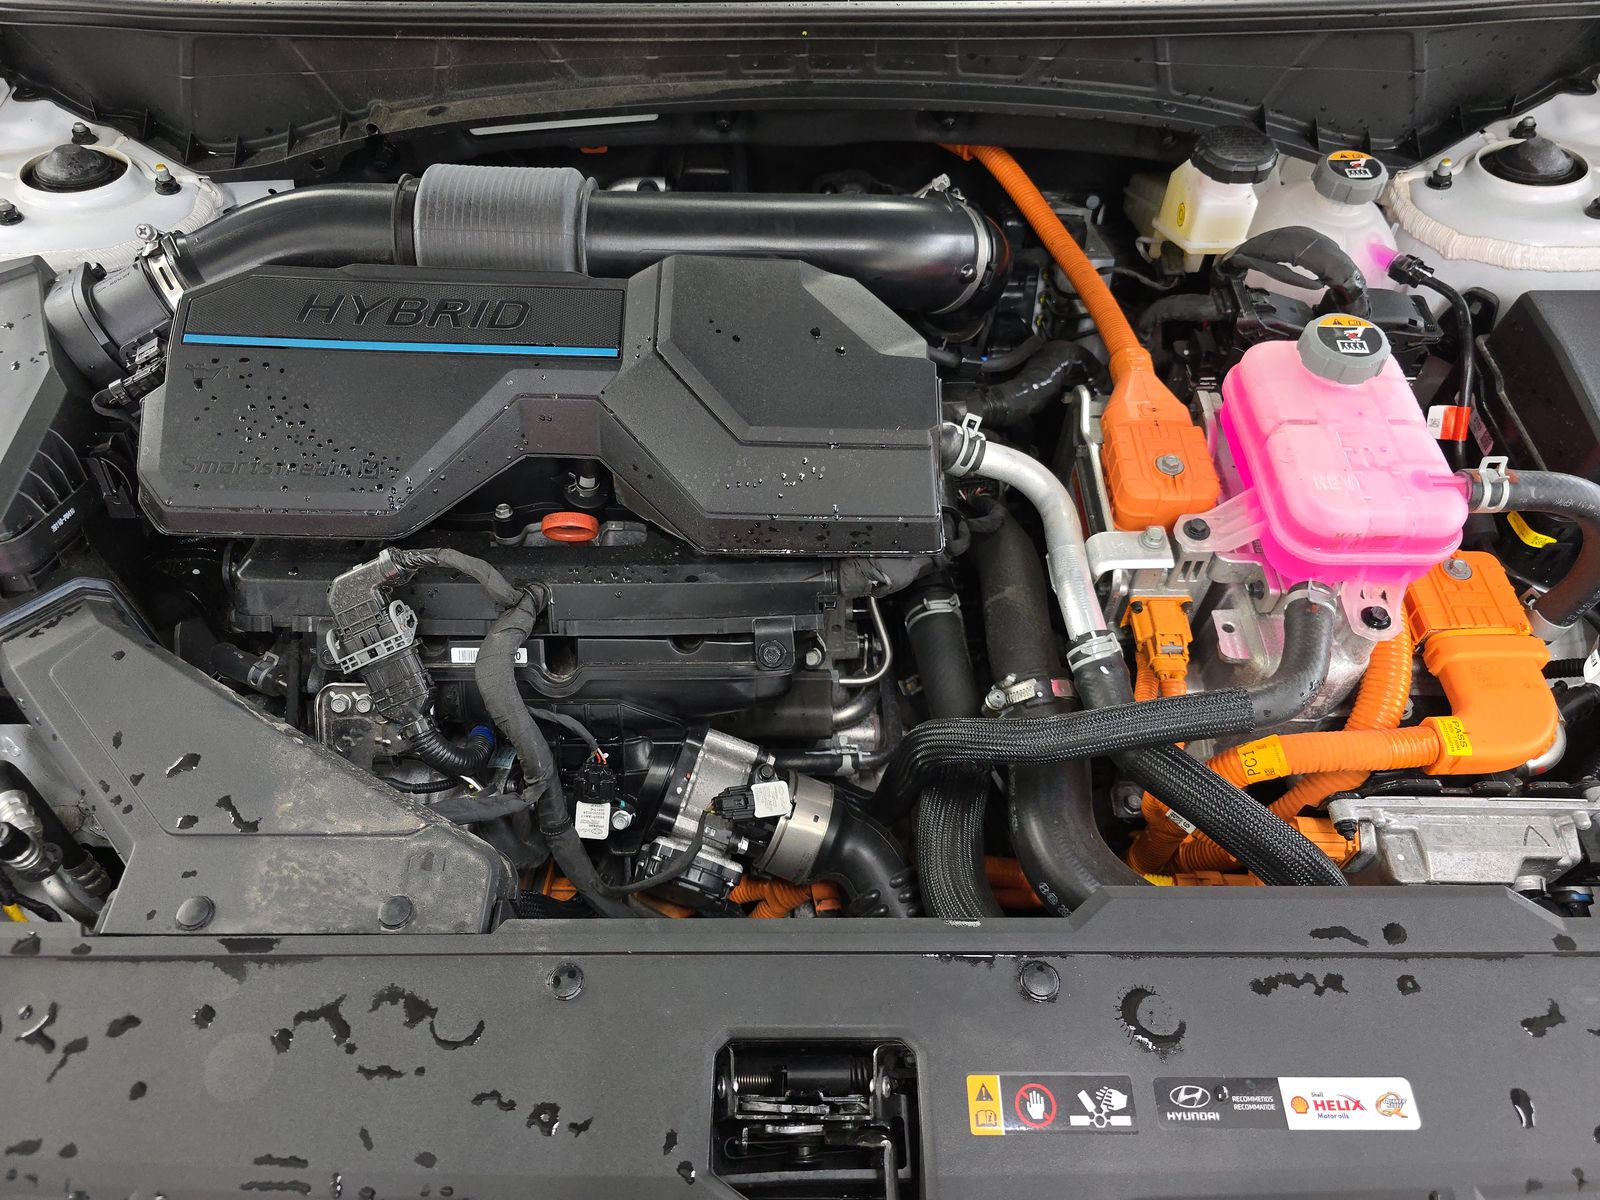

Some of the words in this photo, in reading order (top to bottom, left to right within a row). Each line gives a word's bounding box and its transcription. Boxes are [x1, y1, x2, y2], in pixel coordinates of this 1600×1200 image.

[295, 293, 531, 331] HYBRID
[179, 456, 352, 477] Smartstream
[1451, 720, 1468, 748] PASS
[1242, 750, 1261, 777] PC1
[1231, 1095, 1274, 1103] RECOMMENDS
[1313, 1097, 1367, 1111] HELIX
[1233, 1103, 1277, 1111] RECOMMANDE
[1166, 1111, 1220, 1121] HYUNDAI
[1317, 1112, 1336, 1120] Motor
[1338, 1112, 1350, 1120] oils
